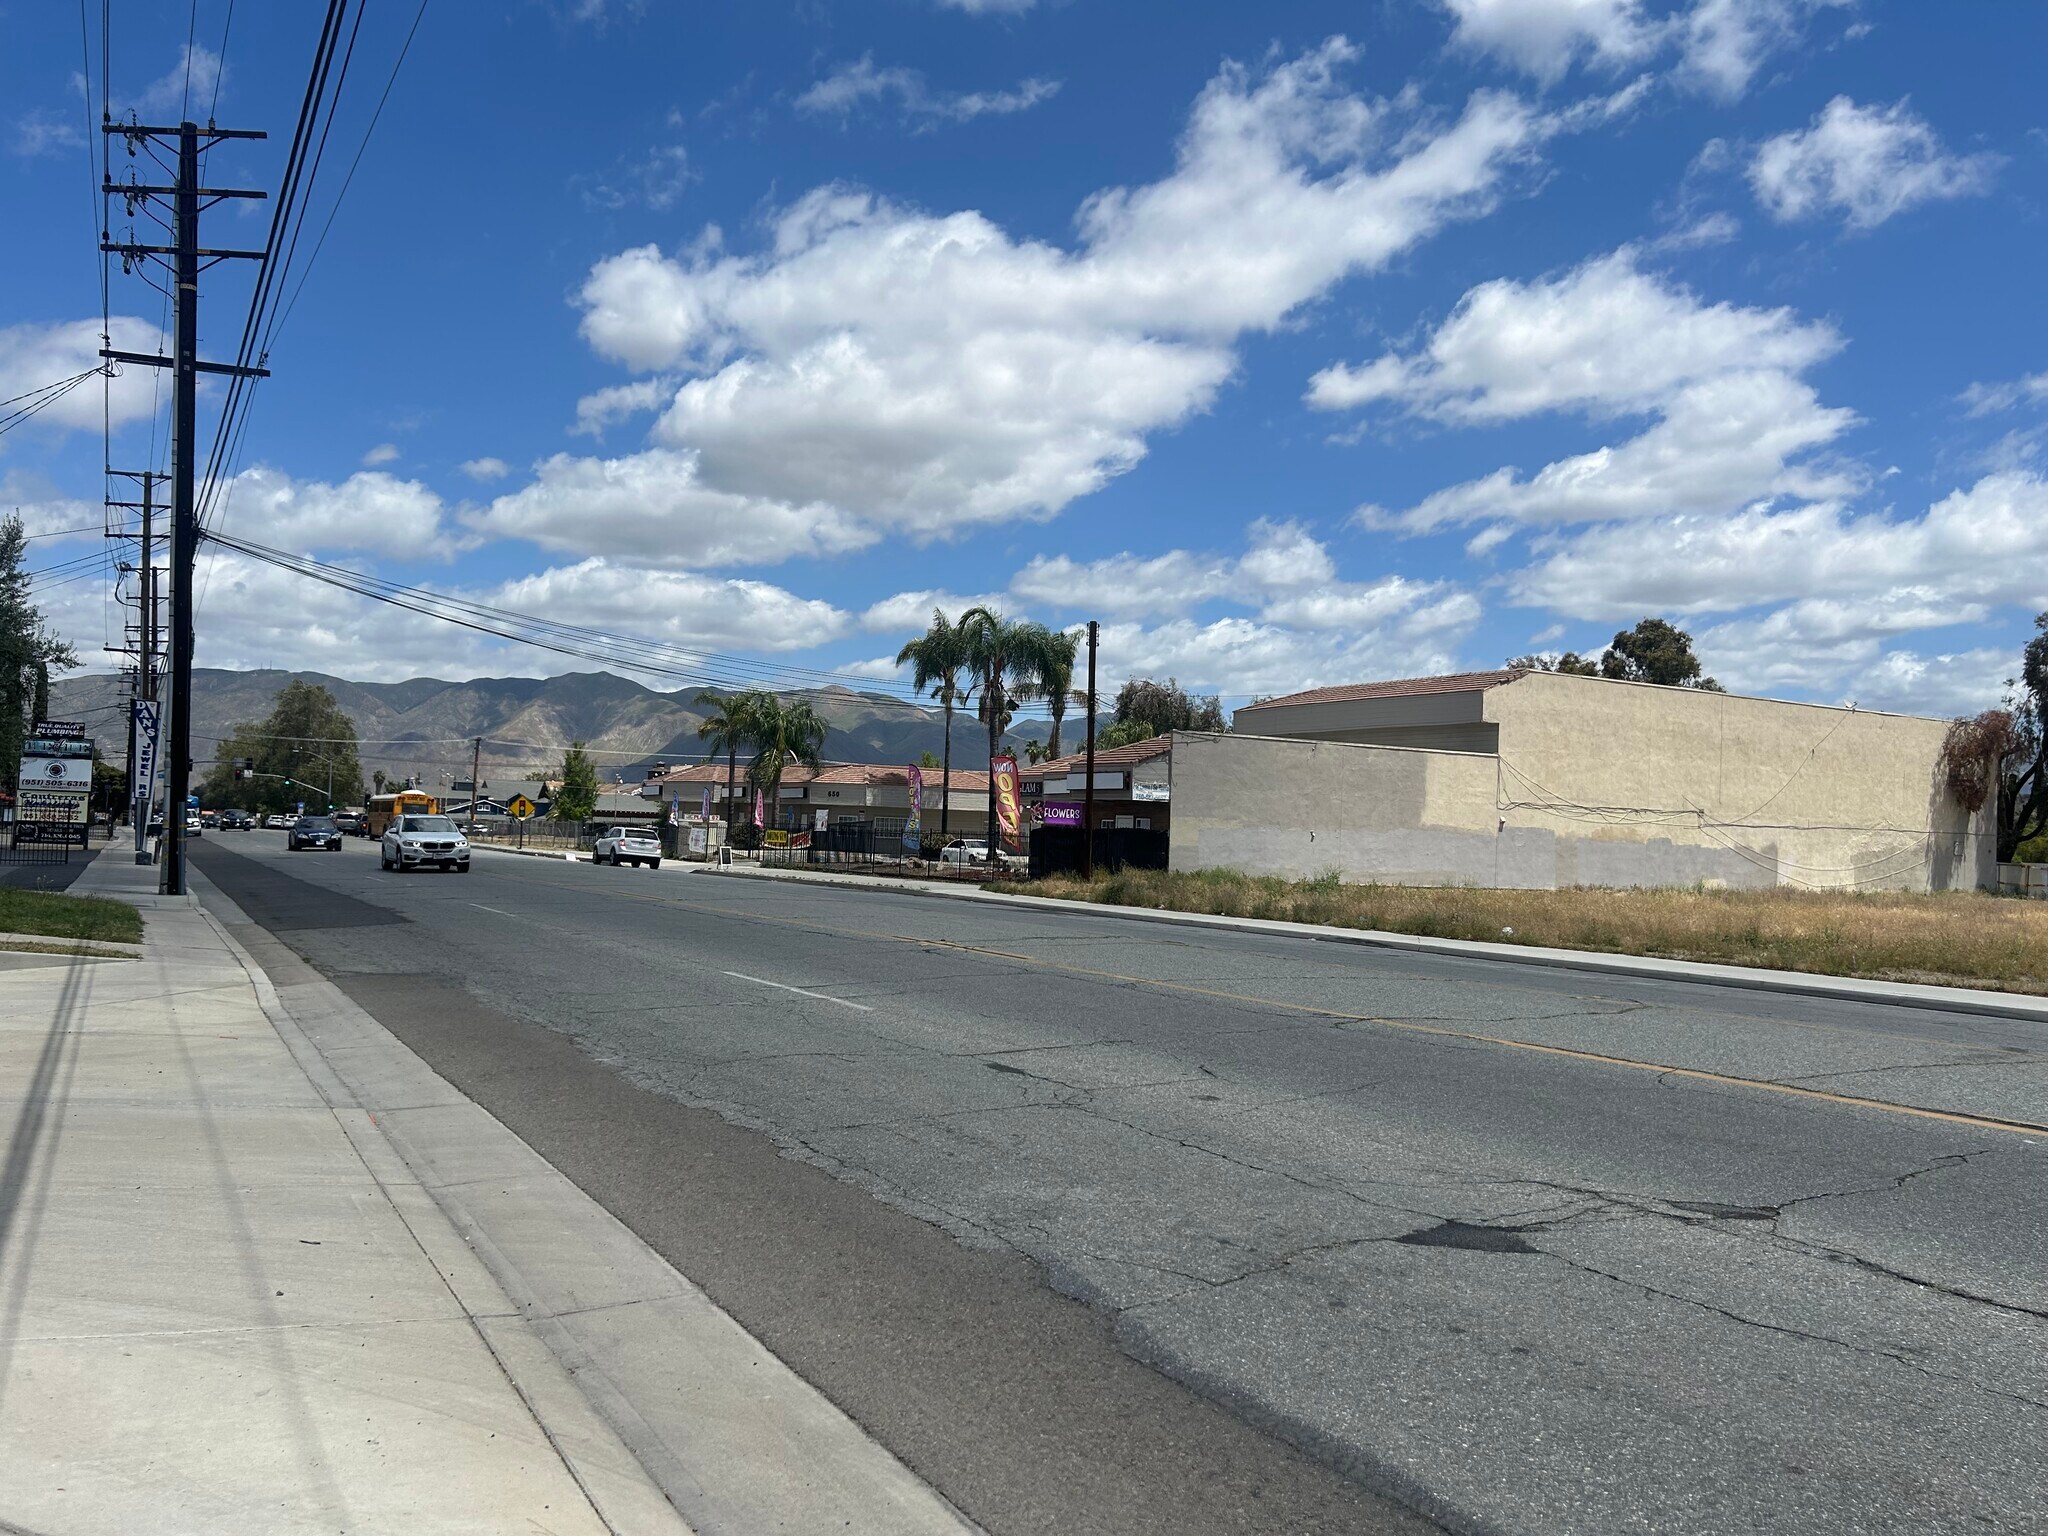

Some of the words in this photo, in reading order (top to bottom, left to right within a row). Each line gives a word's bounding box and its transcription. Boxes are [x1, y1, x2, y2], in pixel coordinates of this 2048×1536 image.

[35, 728, 79, 736] PLUMBING
[19, 792, 86, 801] Contreras
[1043, 807, 1081, 819] FLOWERS
